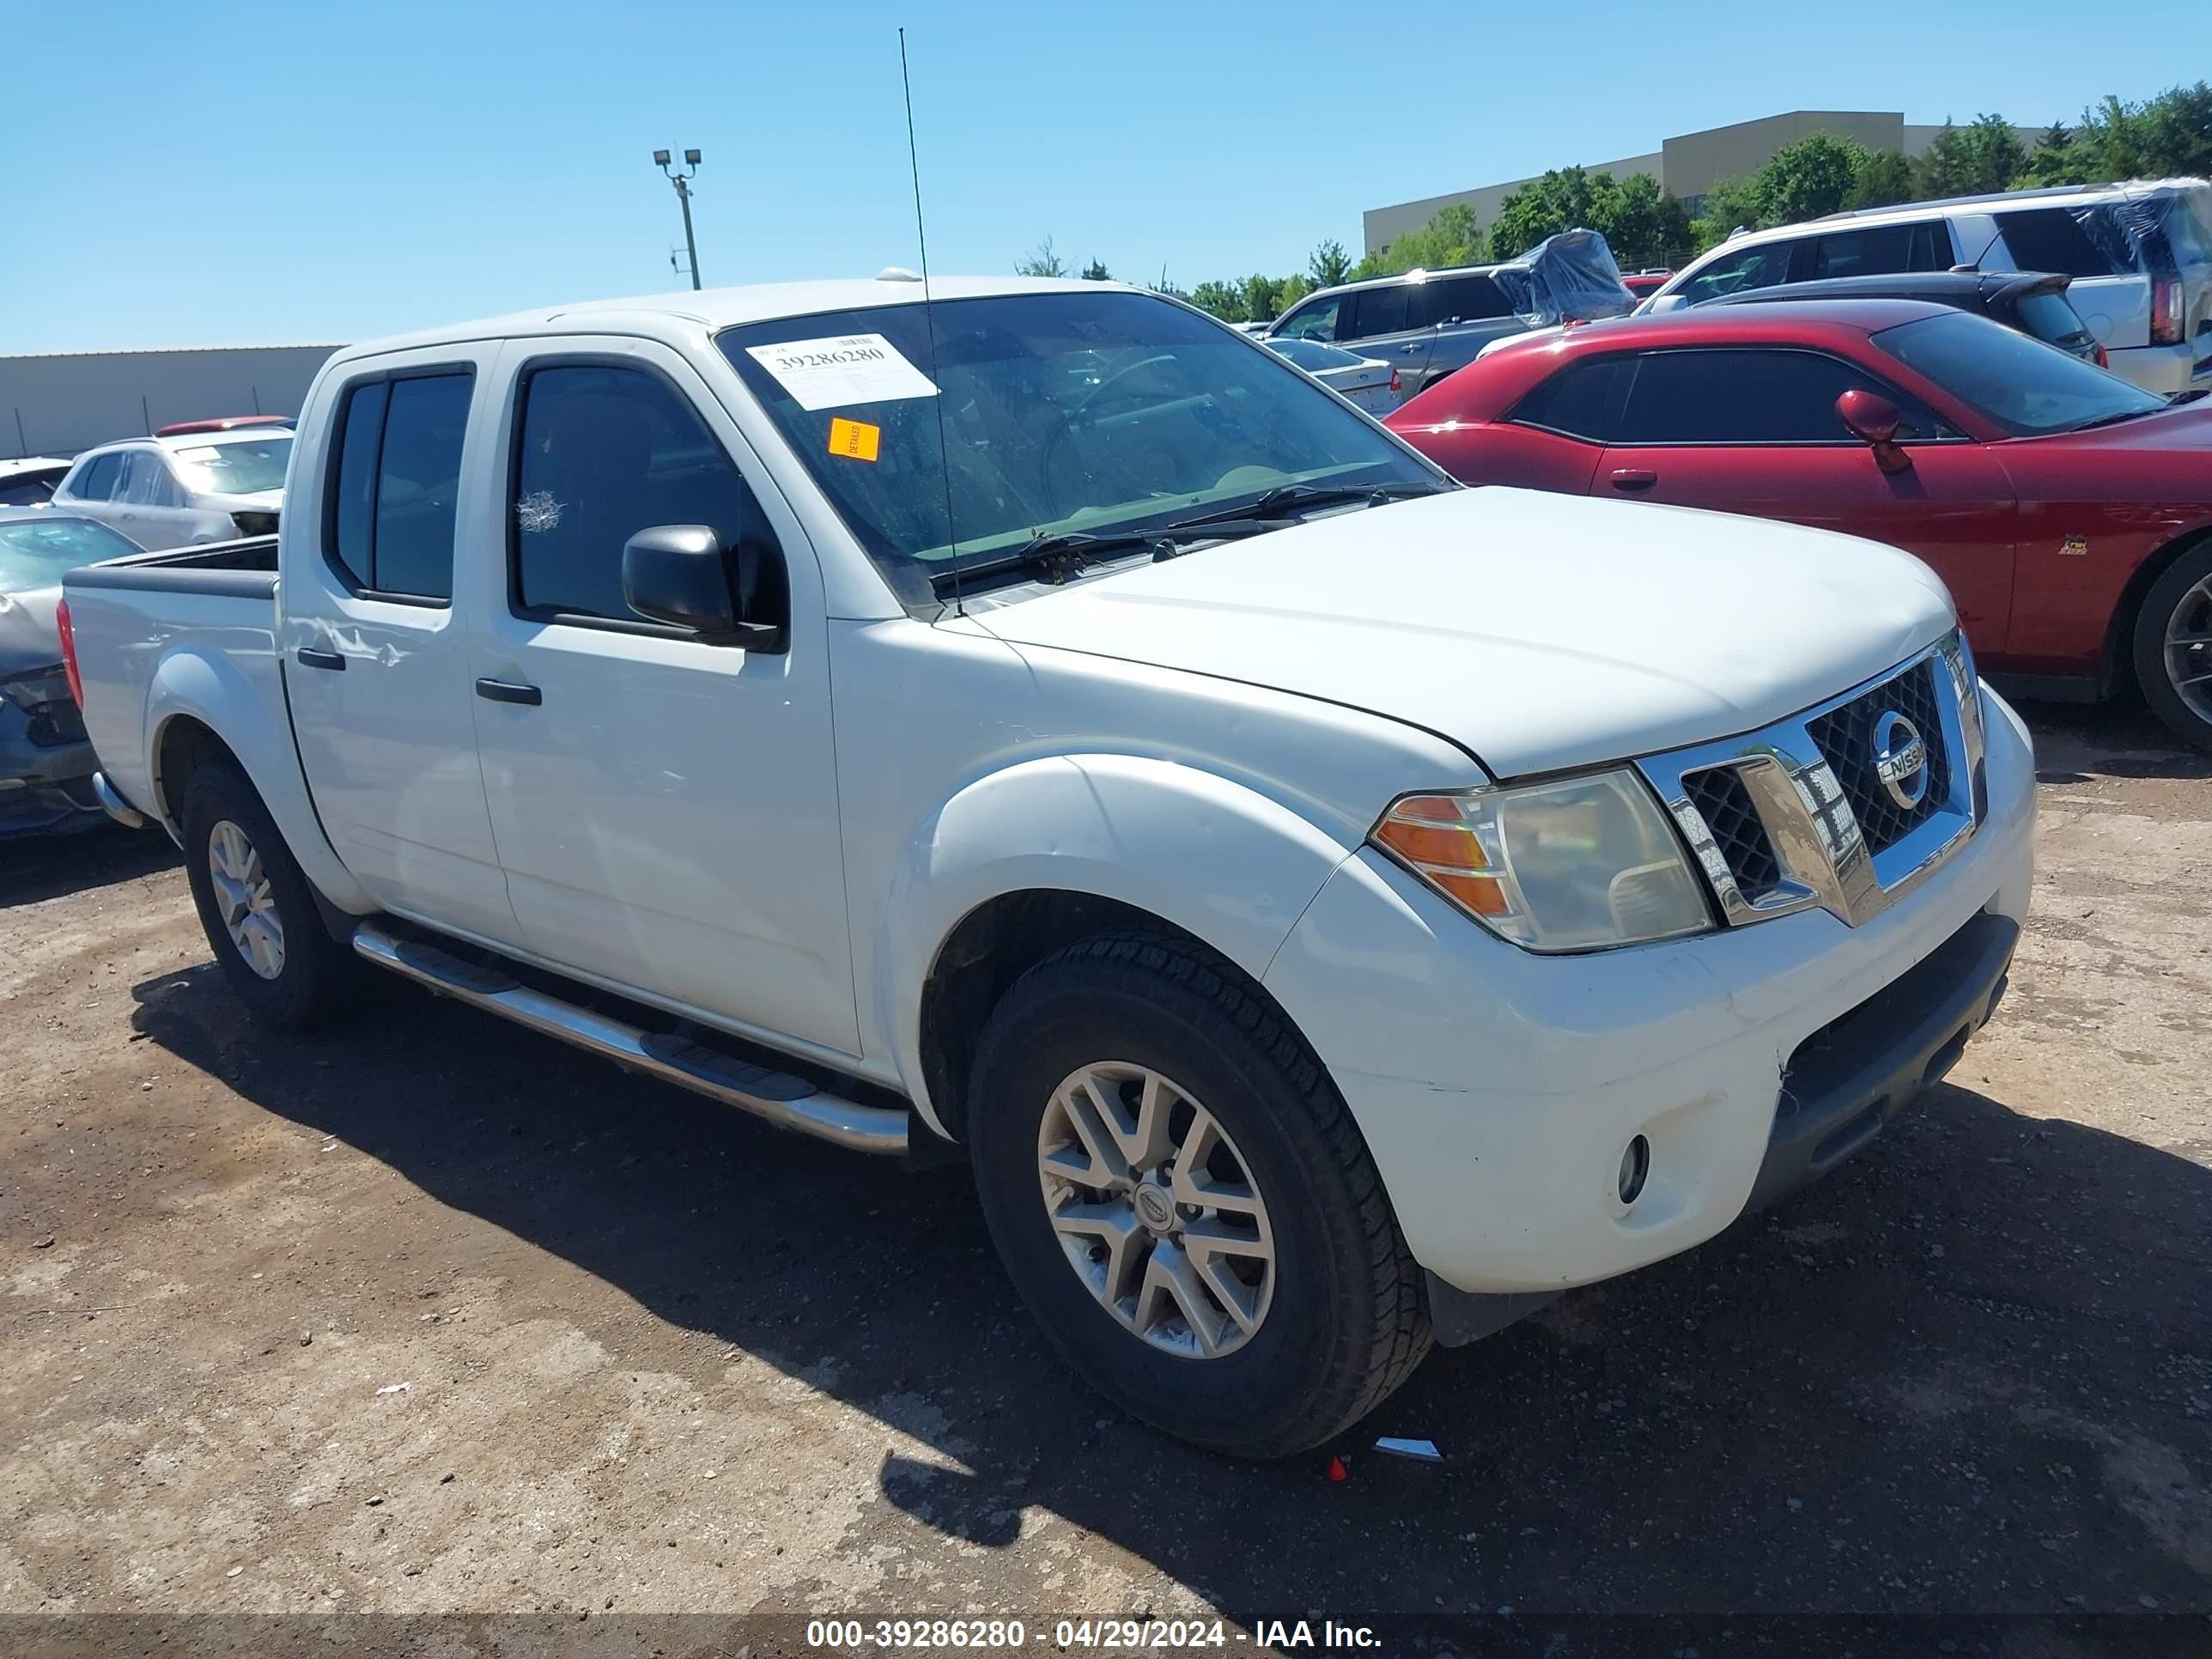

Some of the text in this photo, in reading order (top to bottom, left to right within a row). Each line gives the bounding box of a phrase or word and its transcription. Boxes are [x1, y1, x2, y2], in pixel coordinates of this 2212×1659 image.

[776, 348, 885, 370] 39286280
[848, 425, 860, 454] DETAILED
[1889, 743, 1924, 777] NISS
